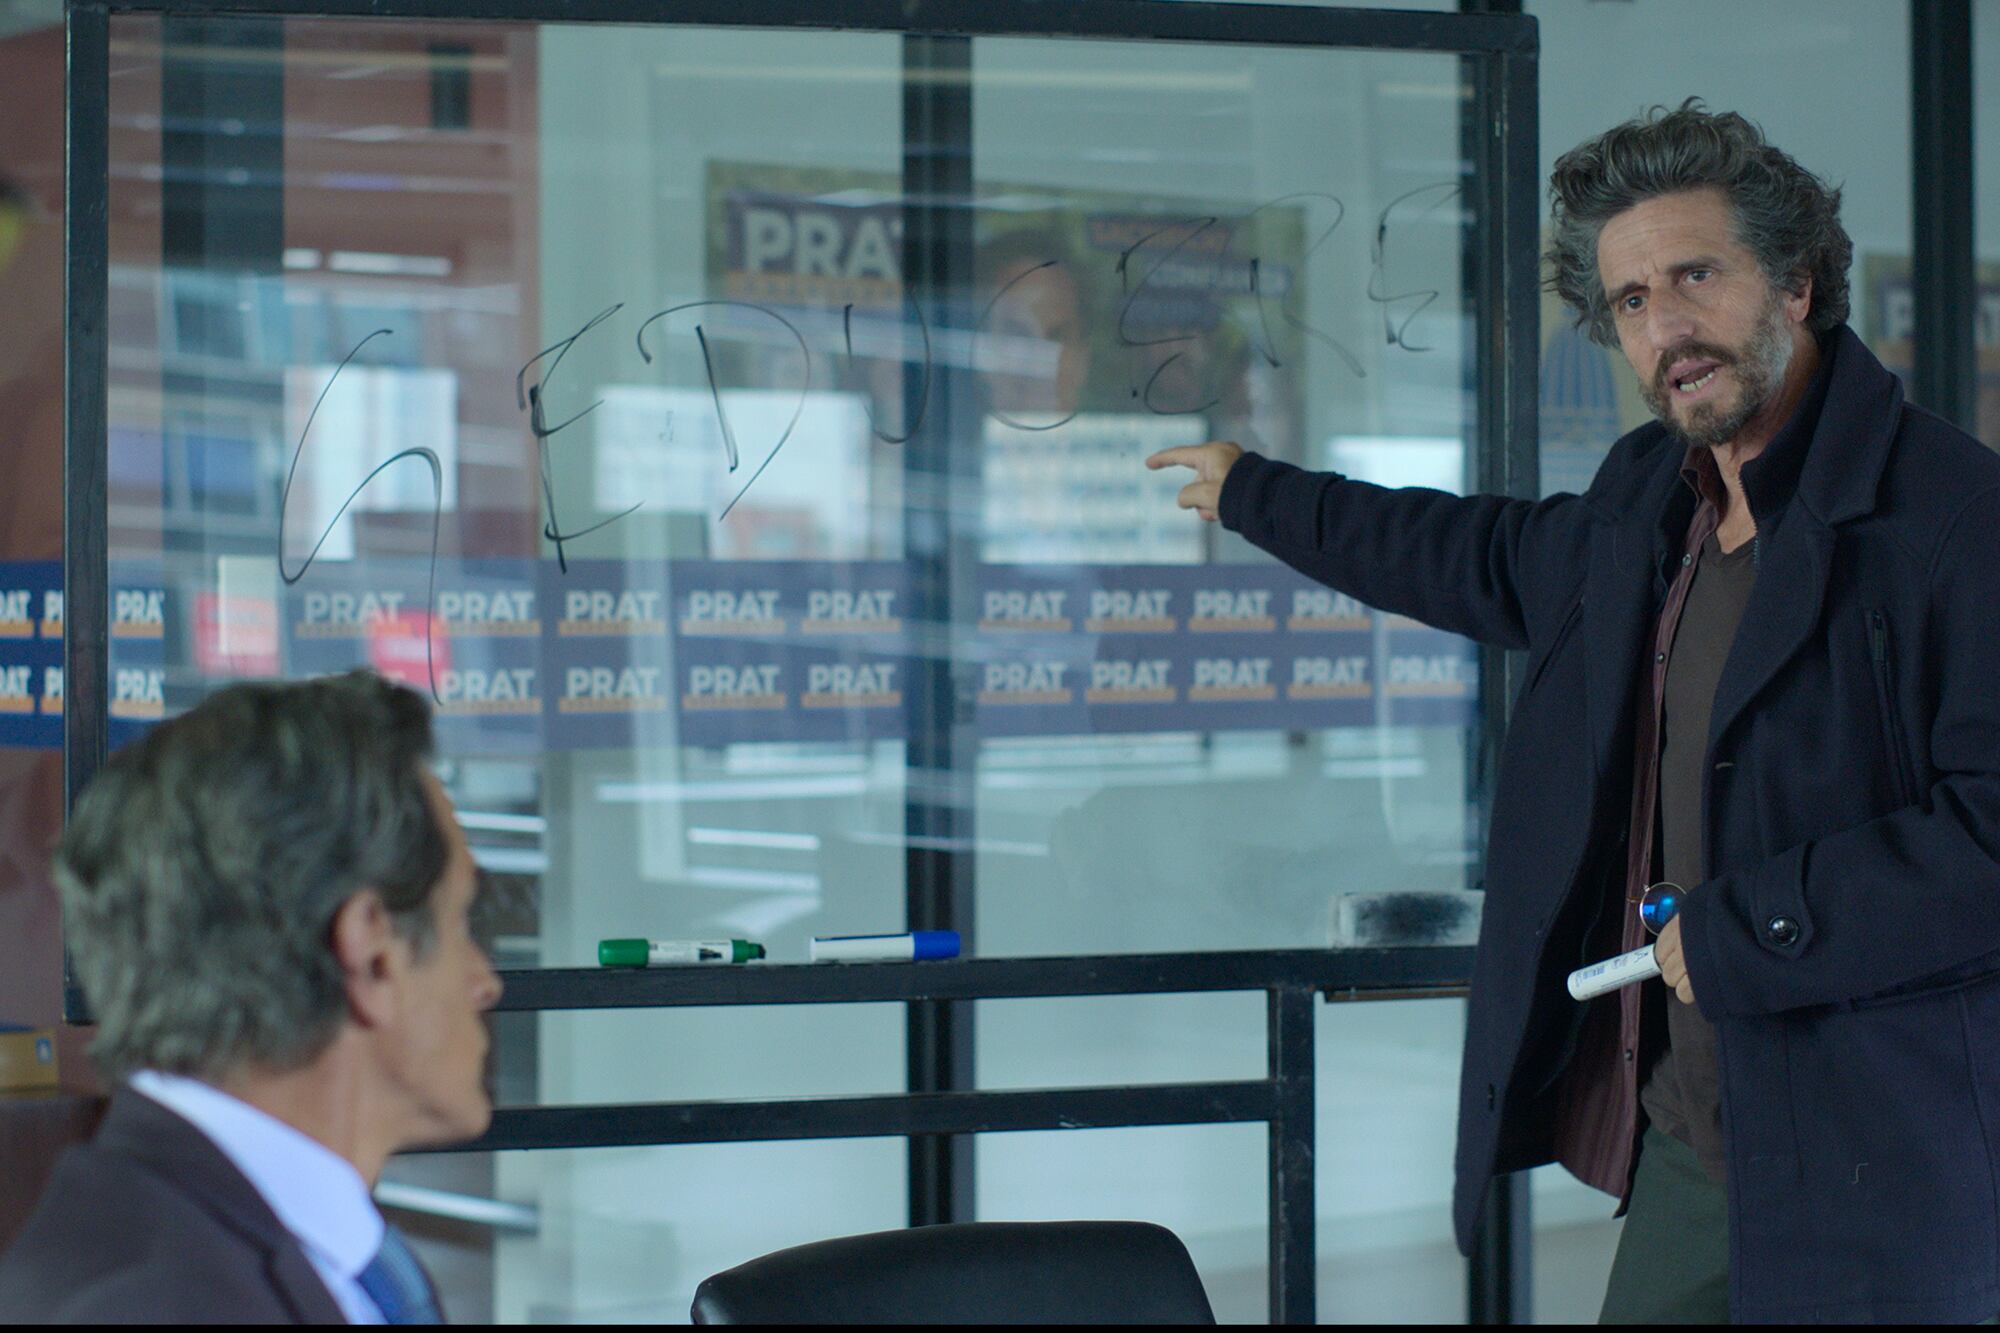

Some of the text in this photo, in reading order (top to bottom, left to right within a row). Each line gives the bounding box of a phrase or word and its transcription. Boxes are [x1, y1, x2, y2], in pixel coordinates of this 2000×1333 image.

[744, 208, 904, 284] PRA
[115, 590, 165, 622] PRA
[305, 592, 403, 623] PRAT
[438, 591, 535, 622] PRAT
[566, 591, 660, 622] PRAT
[689, 590, 780, 620] PRAT
[808, 590, 895, 619] PRAT
[984, 591, 1066, 619] PRAT
[1090, 590, 1171, 618] PRAT
[1194, 589, 1270, 617] PRAT
[115, 669, 165, 700] PRA
[440, 669, 535, 700] PRAT
[567, 668, 661, 699] PRAT
[690, 665, 780, 695] PRAT
[809, 664, 895, 693] PRAT
[985, 662, 1067, 690] PRAT
[1092, 661, 1171, 688] PRAT
[1194, 659, 1271, 686] PRAT
[1294, 657, 1366, 684] PRAT
[1388, 656, 1460, 682] PRAT
